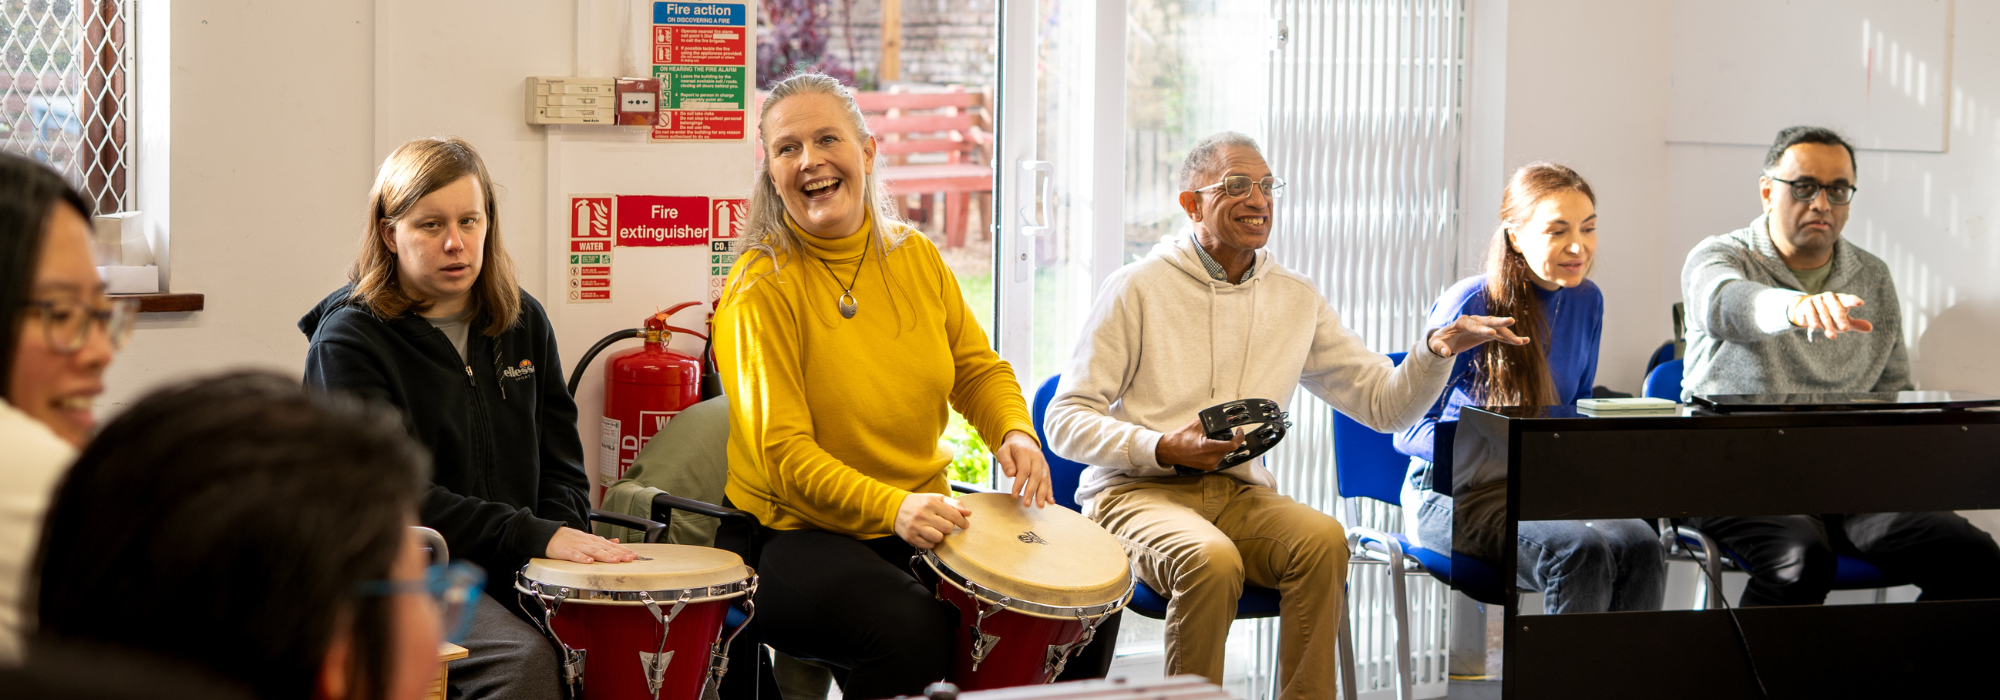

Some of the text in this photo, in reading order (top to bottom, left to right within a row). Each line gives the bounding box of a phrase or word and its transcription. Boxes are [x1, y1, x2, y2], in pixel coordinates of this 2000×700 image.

[666, 4, 732, 16] Fire action
[651, 205, 678, 219] Fire
[620, 225, 708, 241] extinguisher
[579, 242, 604, 251] WATER
